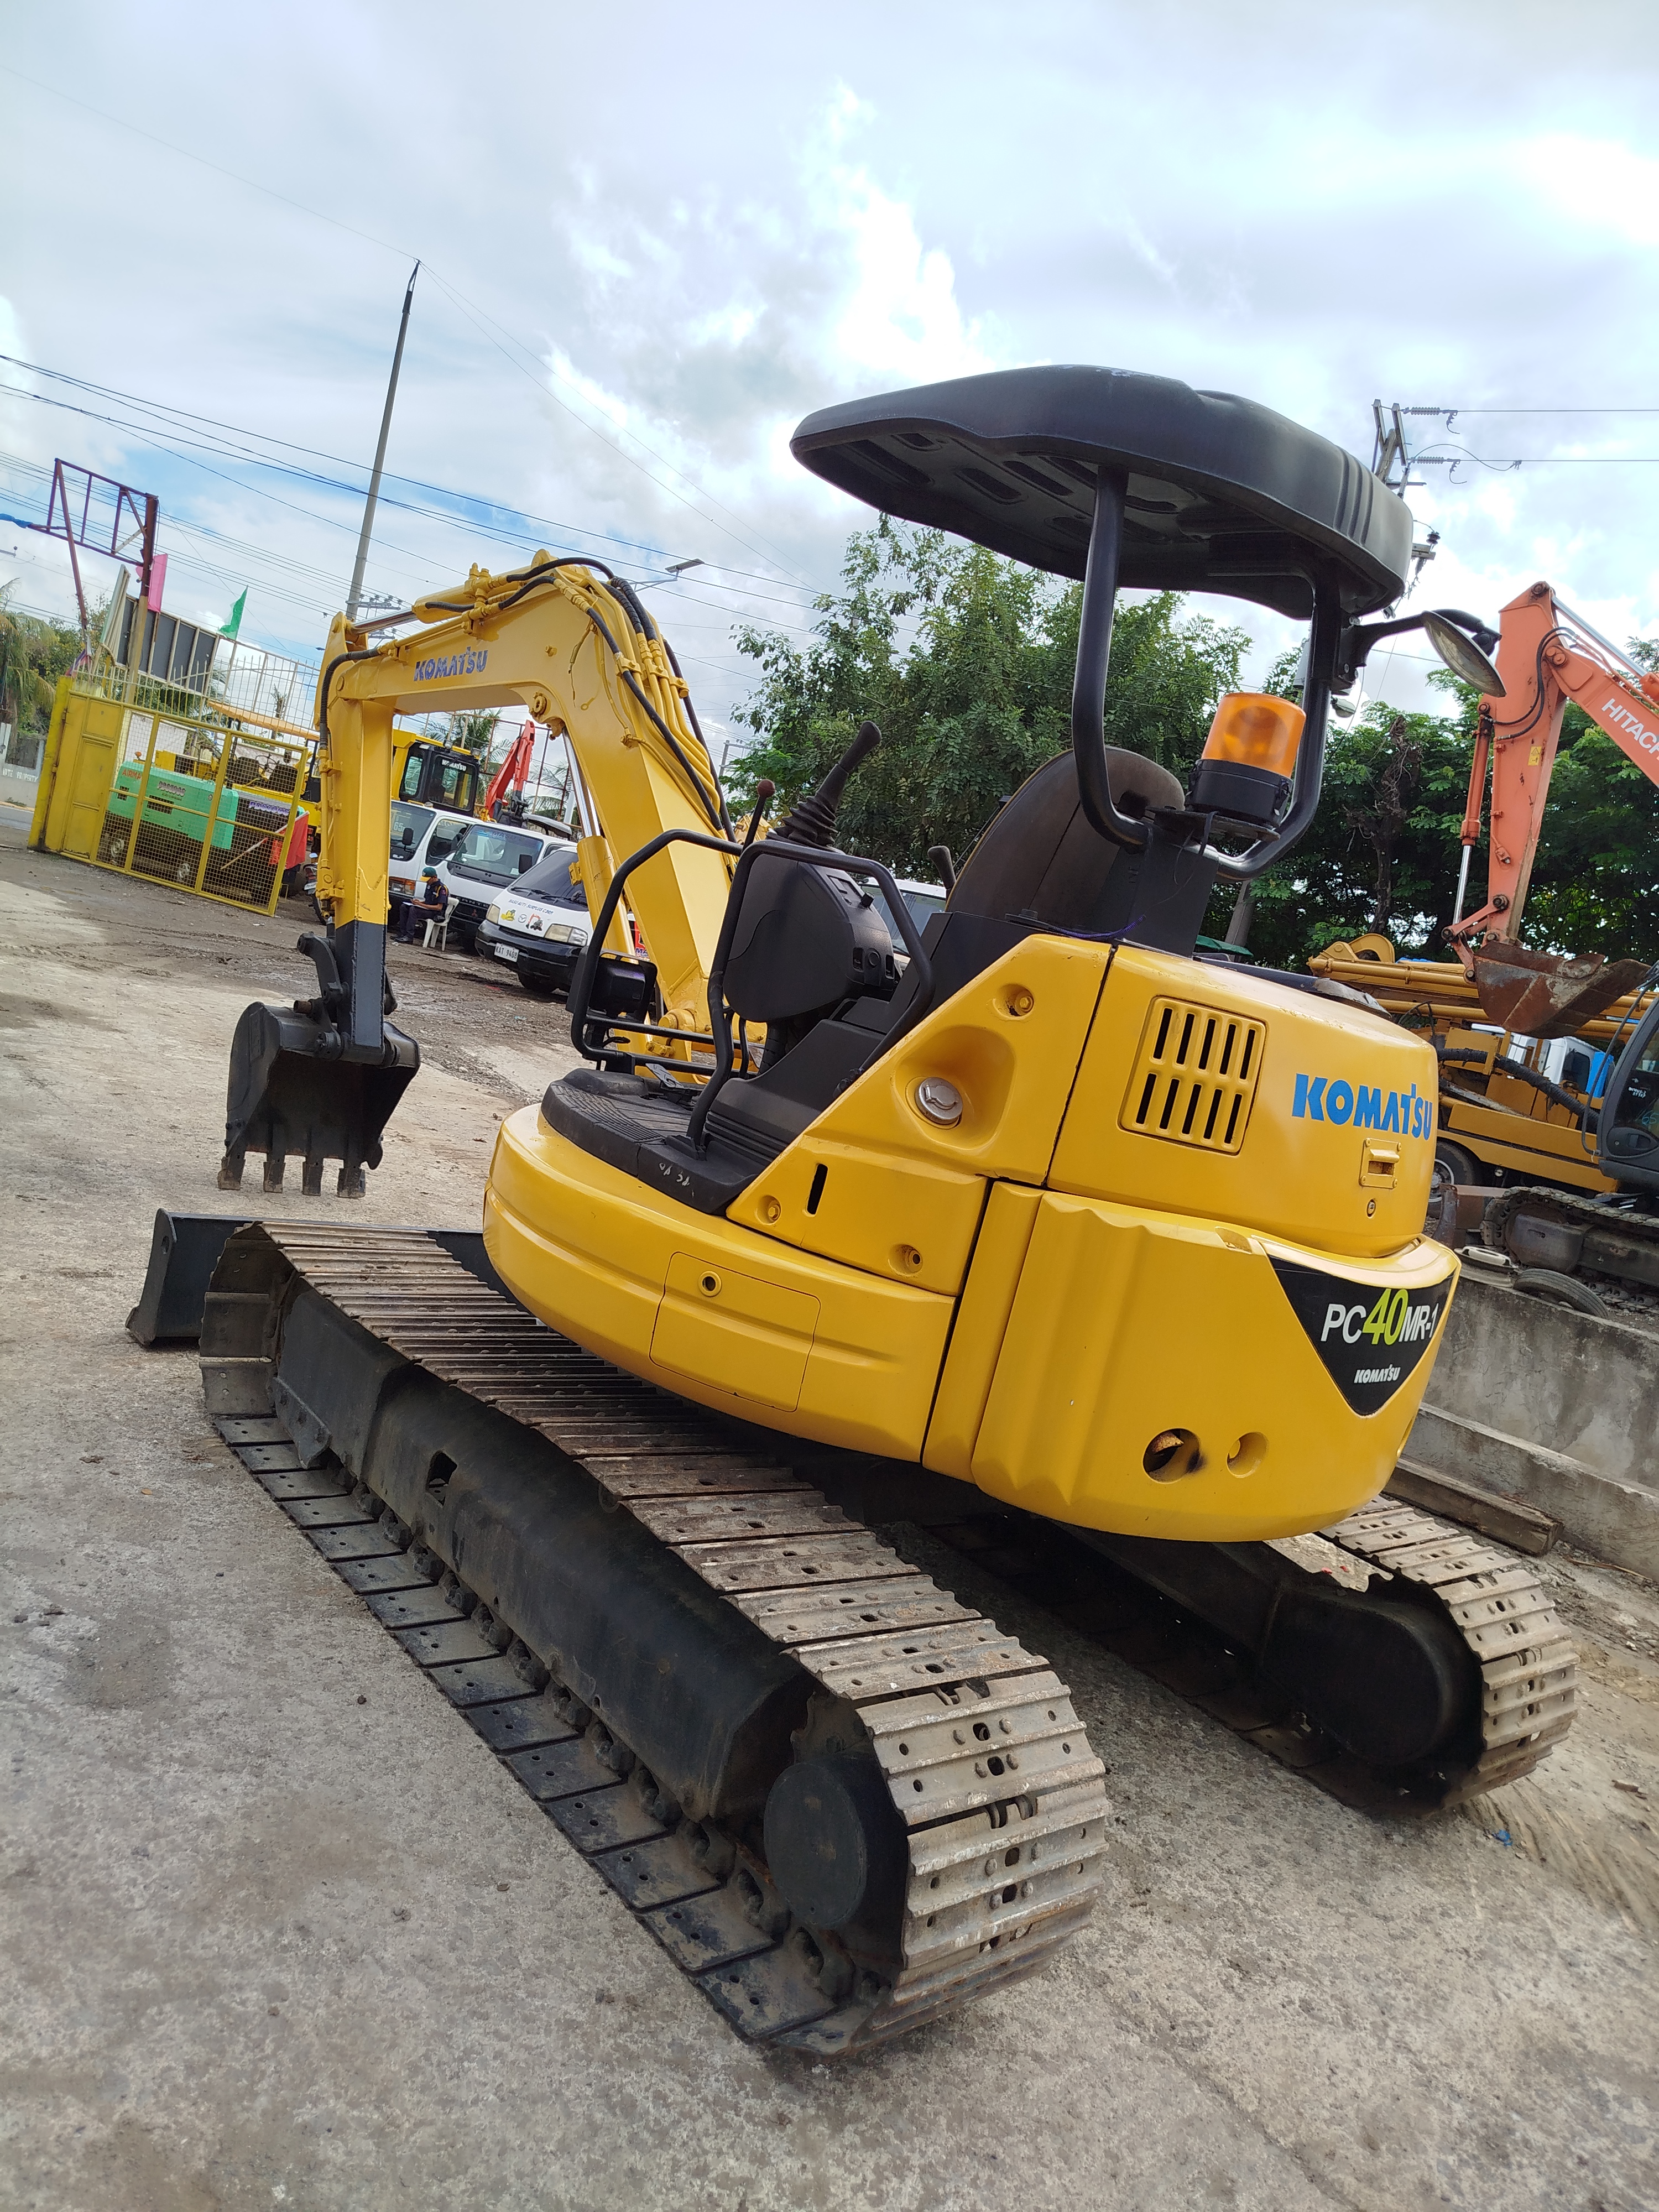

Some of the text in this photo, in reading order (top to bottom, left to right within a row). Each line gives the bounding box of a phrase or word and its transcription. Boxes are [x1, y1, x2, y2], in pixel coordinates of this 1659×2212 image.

[414, 646, 488, 681] KOMATSU
[442, 759, 466, 771] KOMATSU
[495, 946, 518, 959] KAT 9408
[1292, 1073, 1433, 1140] KOMATSU
[1321, 1288, 1439, 1345] PC40MR-1
[1354, 1364, 1401, 1384] KOMATSU
